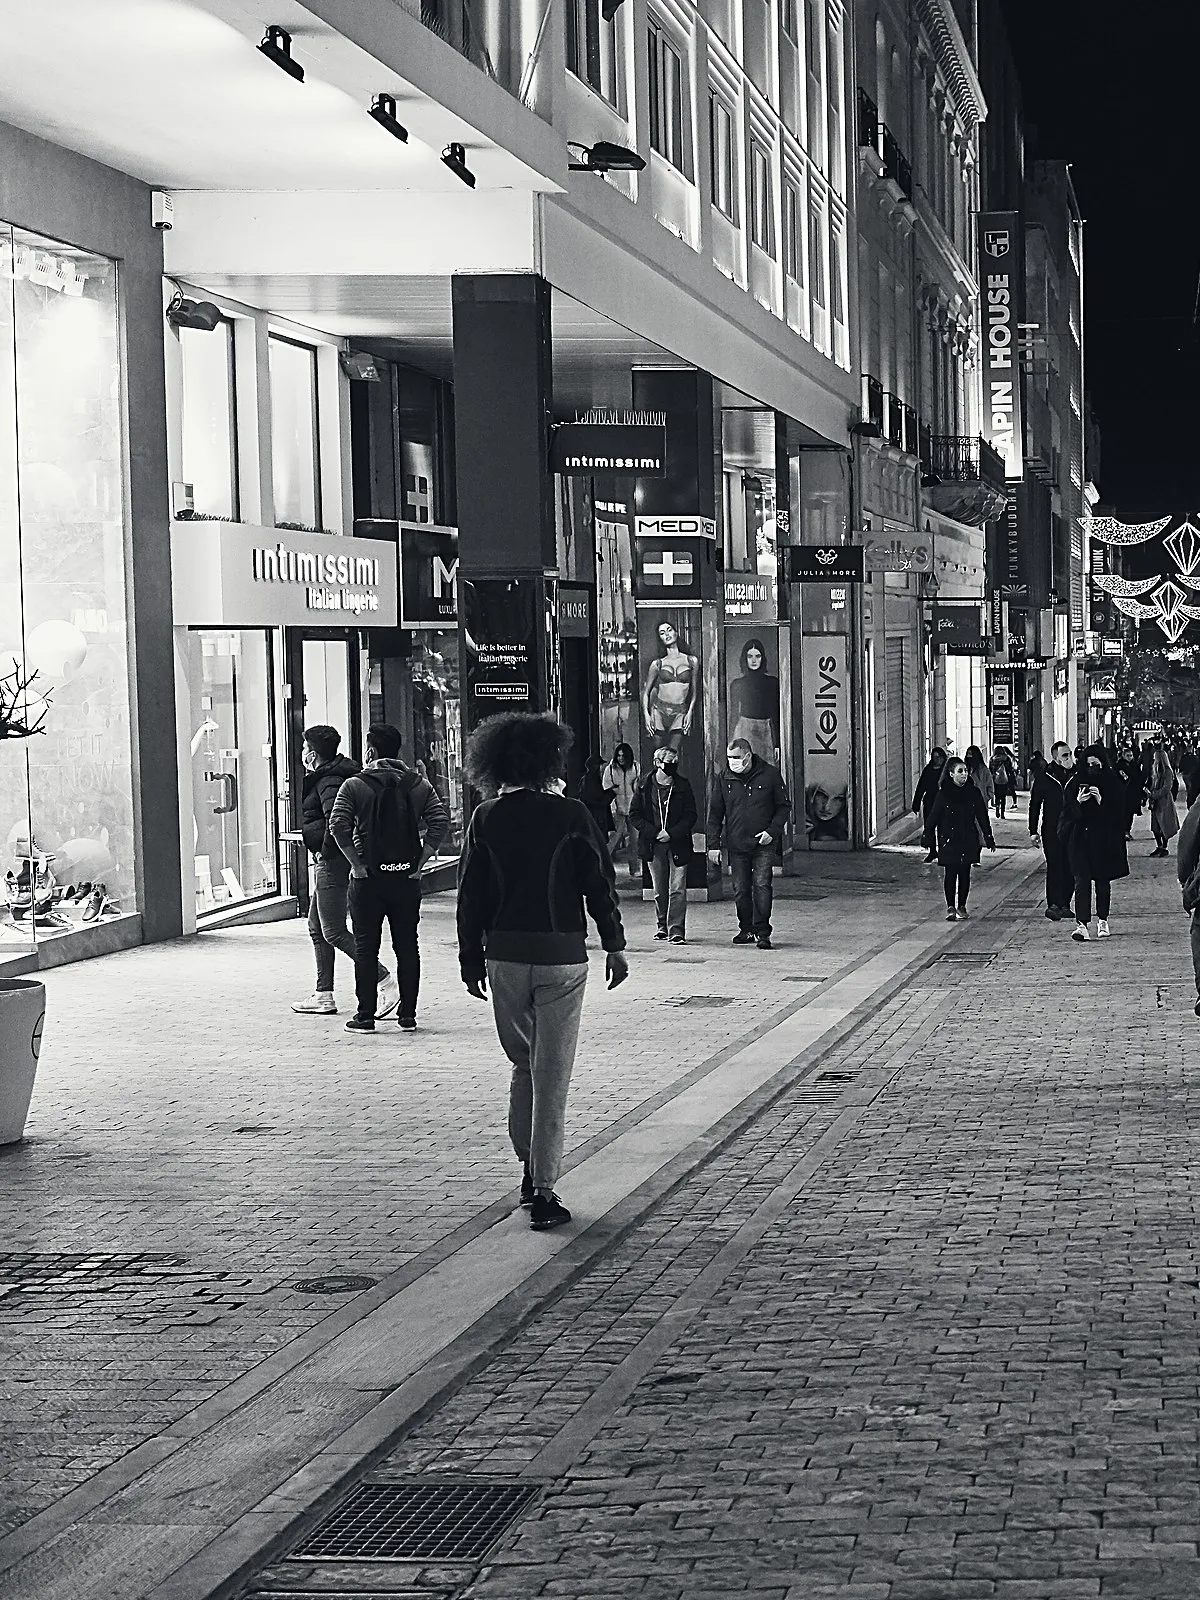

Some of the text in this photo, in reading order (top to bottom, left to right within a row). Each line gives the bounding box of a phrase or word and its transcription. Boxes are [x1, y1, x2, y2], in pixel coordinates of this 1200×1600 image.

[987, 274, 1014, 461] APIN HOUSE
[565, 455, 660, 468] intimissimi
[639, 520, 698, 532] MED
[252, 542, 379, 587] intimissimi
[306, 587, 340, 610] Italian
[808, 655, 841, 755] kellys
[380, 862, 410, 871] adidas
